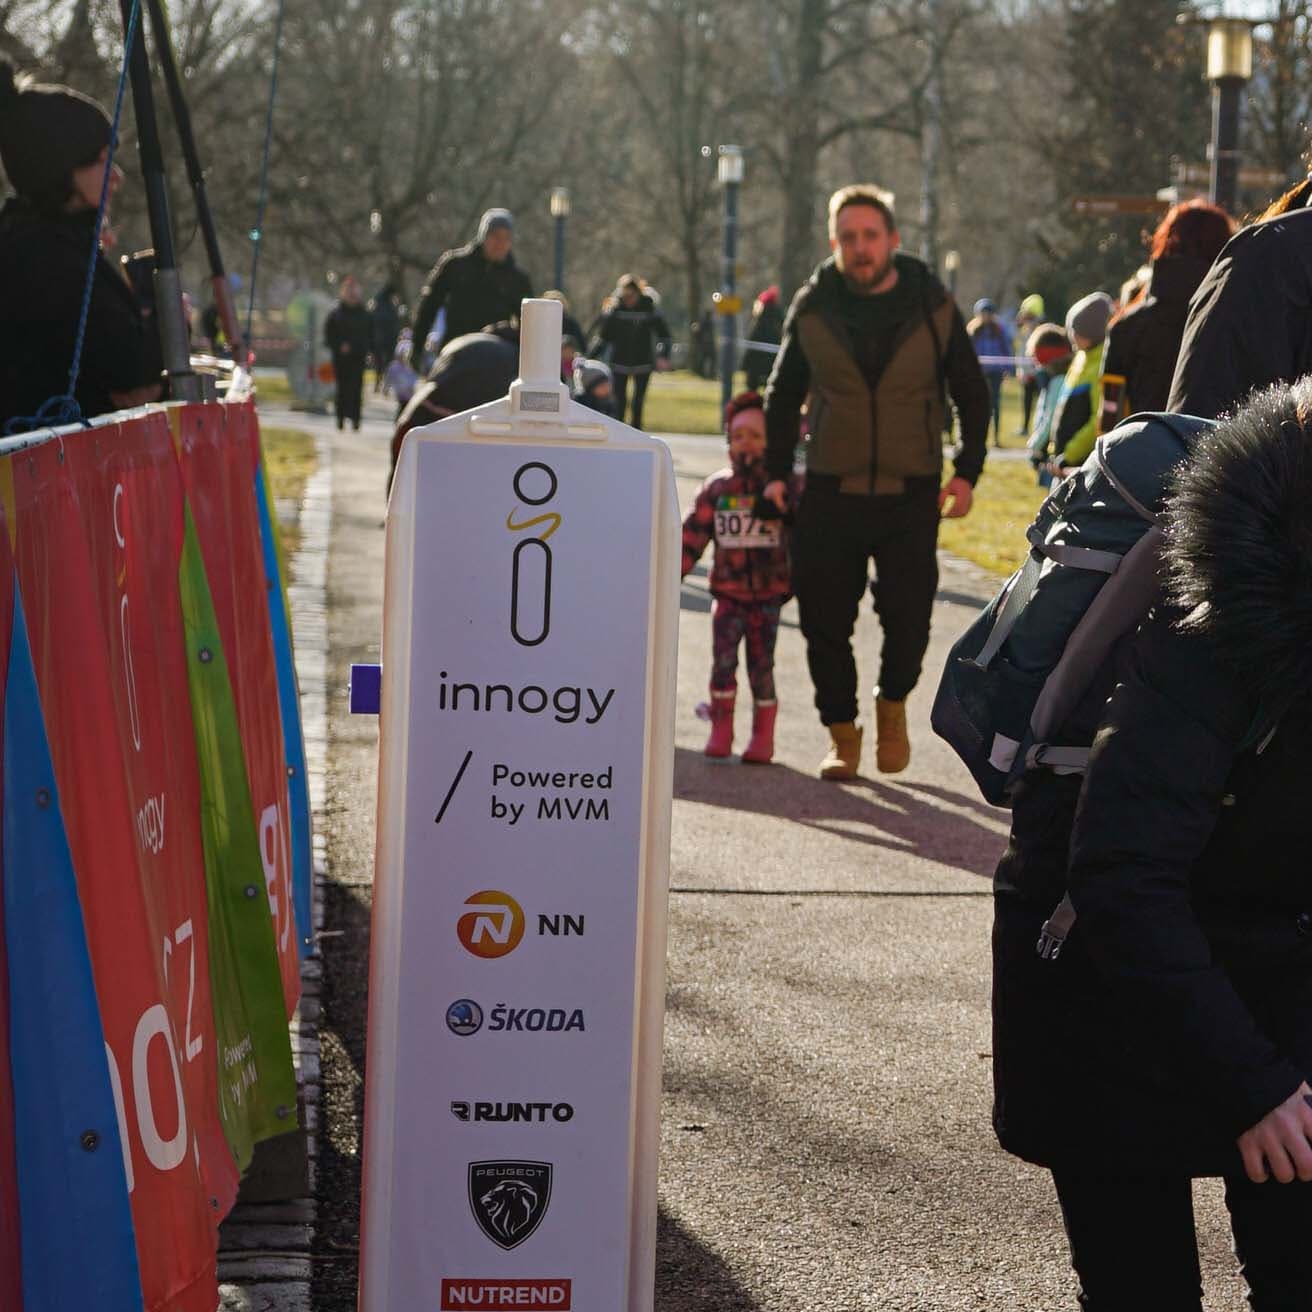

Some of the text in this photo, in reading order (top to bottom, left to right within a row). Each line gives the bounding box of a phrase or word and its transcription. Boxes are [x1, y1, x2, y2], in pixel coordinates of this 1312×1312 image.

[439, 670, 616, 725] innogy
[492, 763, 613, 789] Powered
[490, 794, 610, 826] by MVM
[537, 913, 585, 936] NN
[487, 1003, 586, 1032] ŠKODA
[474, 1101, 575, 1123] RUNTO
[475, 1167, 546, 1178] PEUGEOT
[448, 1284, 566, 1305] NUTREND
